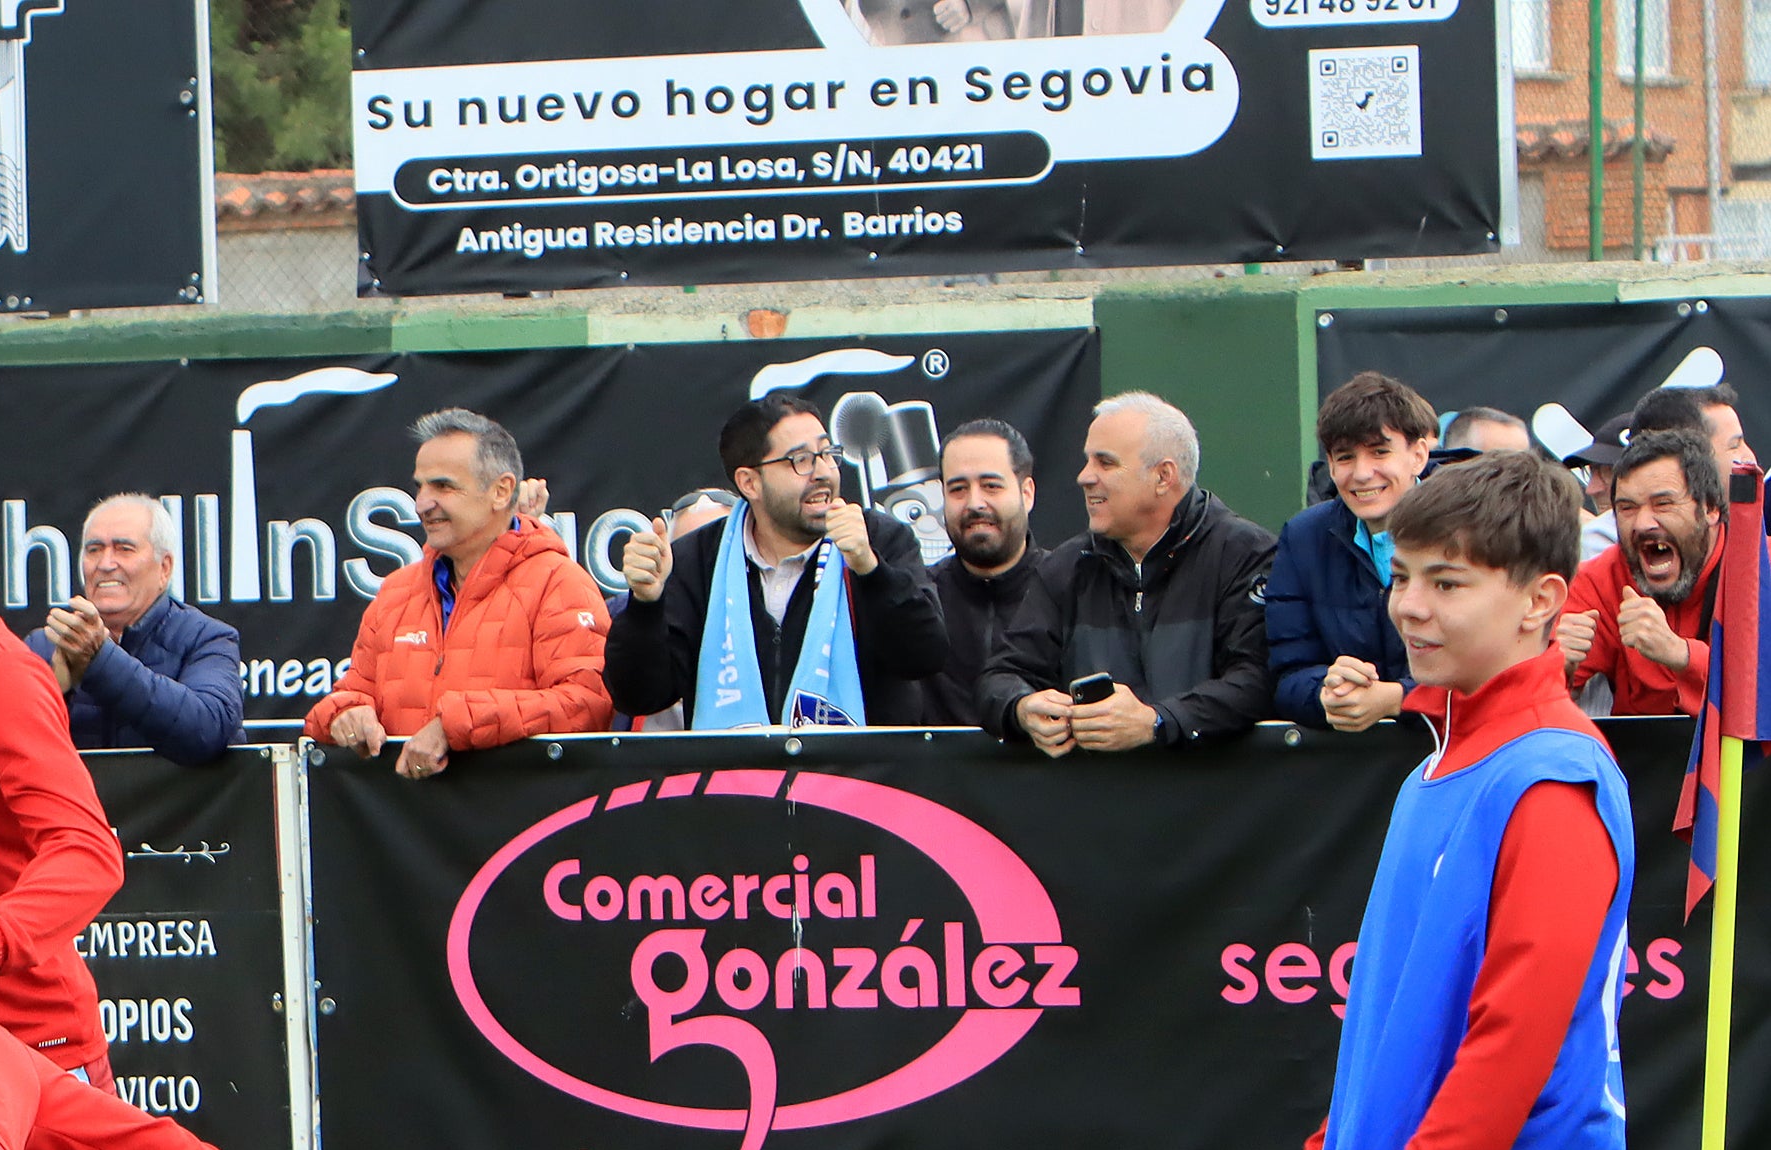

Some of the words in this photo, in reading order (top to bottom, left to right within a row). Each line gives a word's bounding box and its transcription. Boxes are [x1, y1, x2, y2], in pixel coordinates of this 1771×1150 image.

[367, 94, 432, 130] Su
[458, 89, 641, 126] nuevo
[665, 78, 845, 126] hogar
[870, 76, 939, 107] en
[965, 53, 1215, 112] Segovia
[428, 168, 510, 195] Ctra.
[720, 154, 807, 182] Losa,
[811, 143, 882, 184] S/N,
[888, 143, 985, 174] 40421
[456, 222, 588, 258] Antigua
[594, 213, 777, 248] Residencia
[782, 211, 830, 242] Dr.
[843, 206, 964, 239] Barrios
[543, 854, 877, 922] Comercial
[98, 997, 195, 1043] OPIOS
[116, 1074, 202, 1114] VICIO
